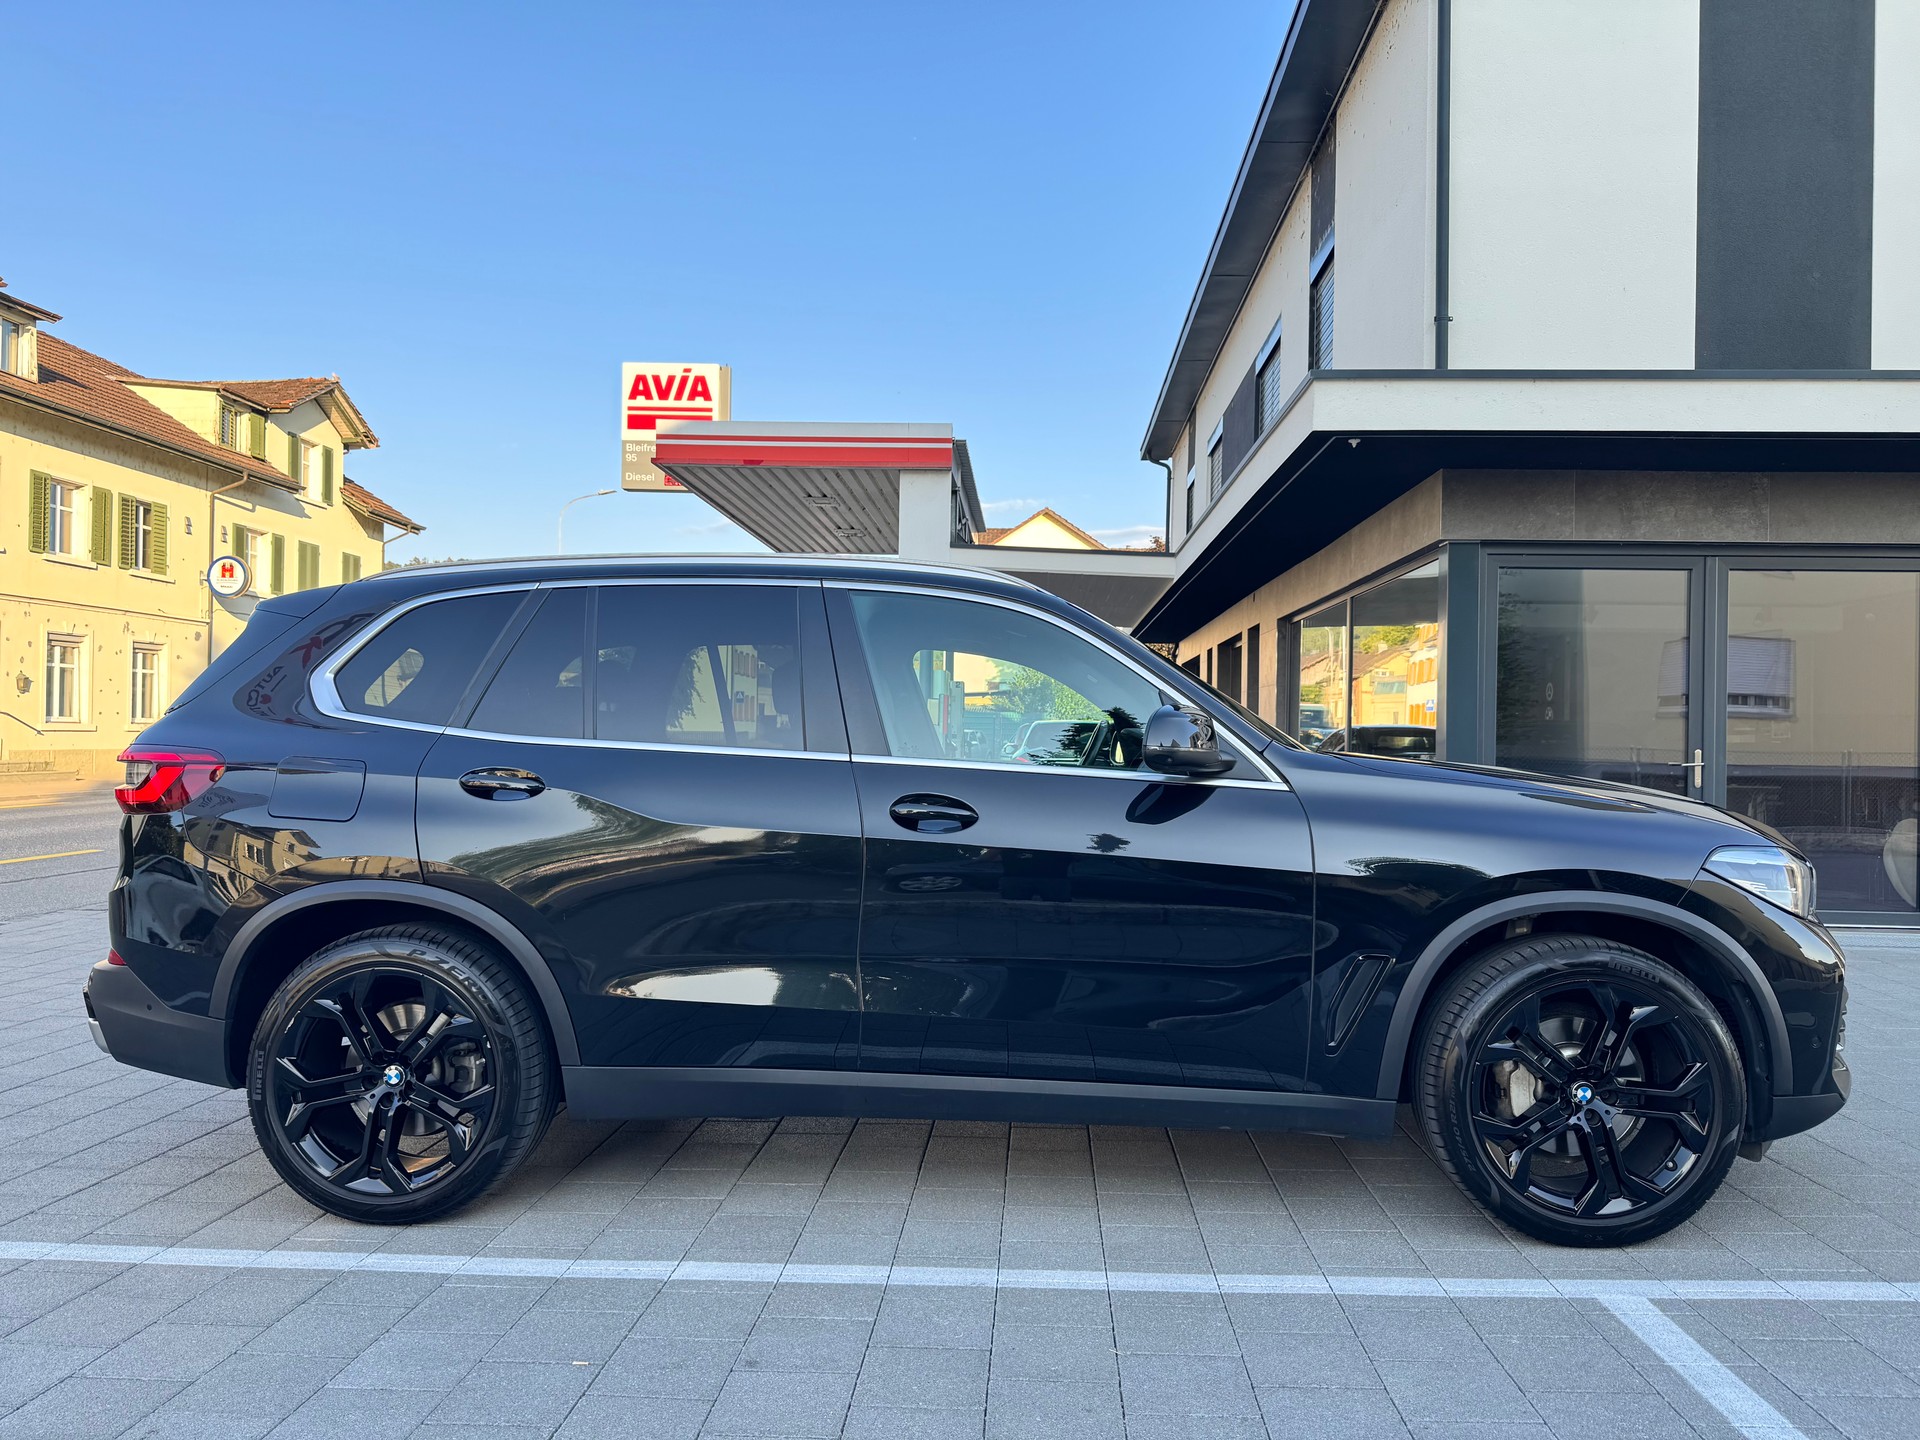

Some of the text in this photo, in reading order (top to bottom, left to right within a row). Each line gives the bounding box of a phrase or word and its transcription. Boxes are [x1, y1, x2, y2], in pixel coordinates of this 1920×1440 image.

[628, 368, 713, 401] AVIA
[626, 453, 637, 462] 95
[626, 472, 655, 481] Diesel
[1608, 955, 1660, 983] PIRELLI
[252, 1049, 264, 1101] PIRELLI
